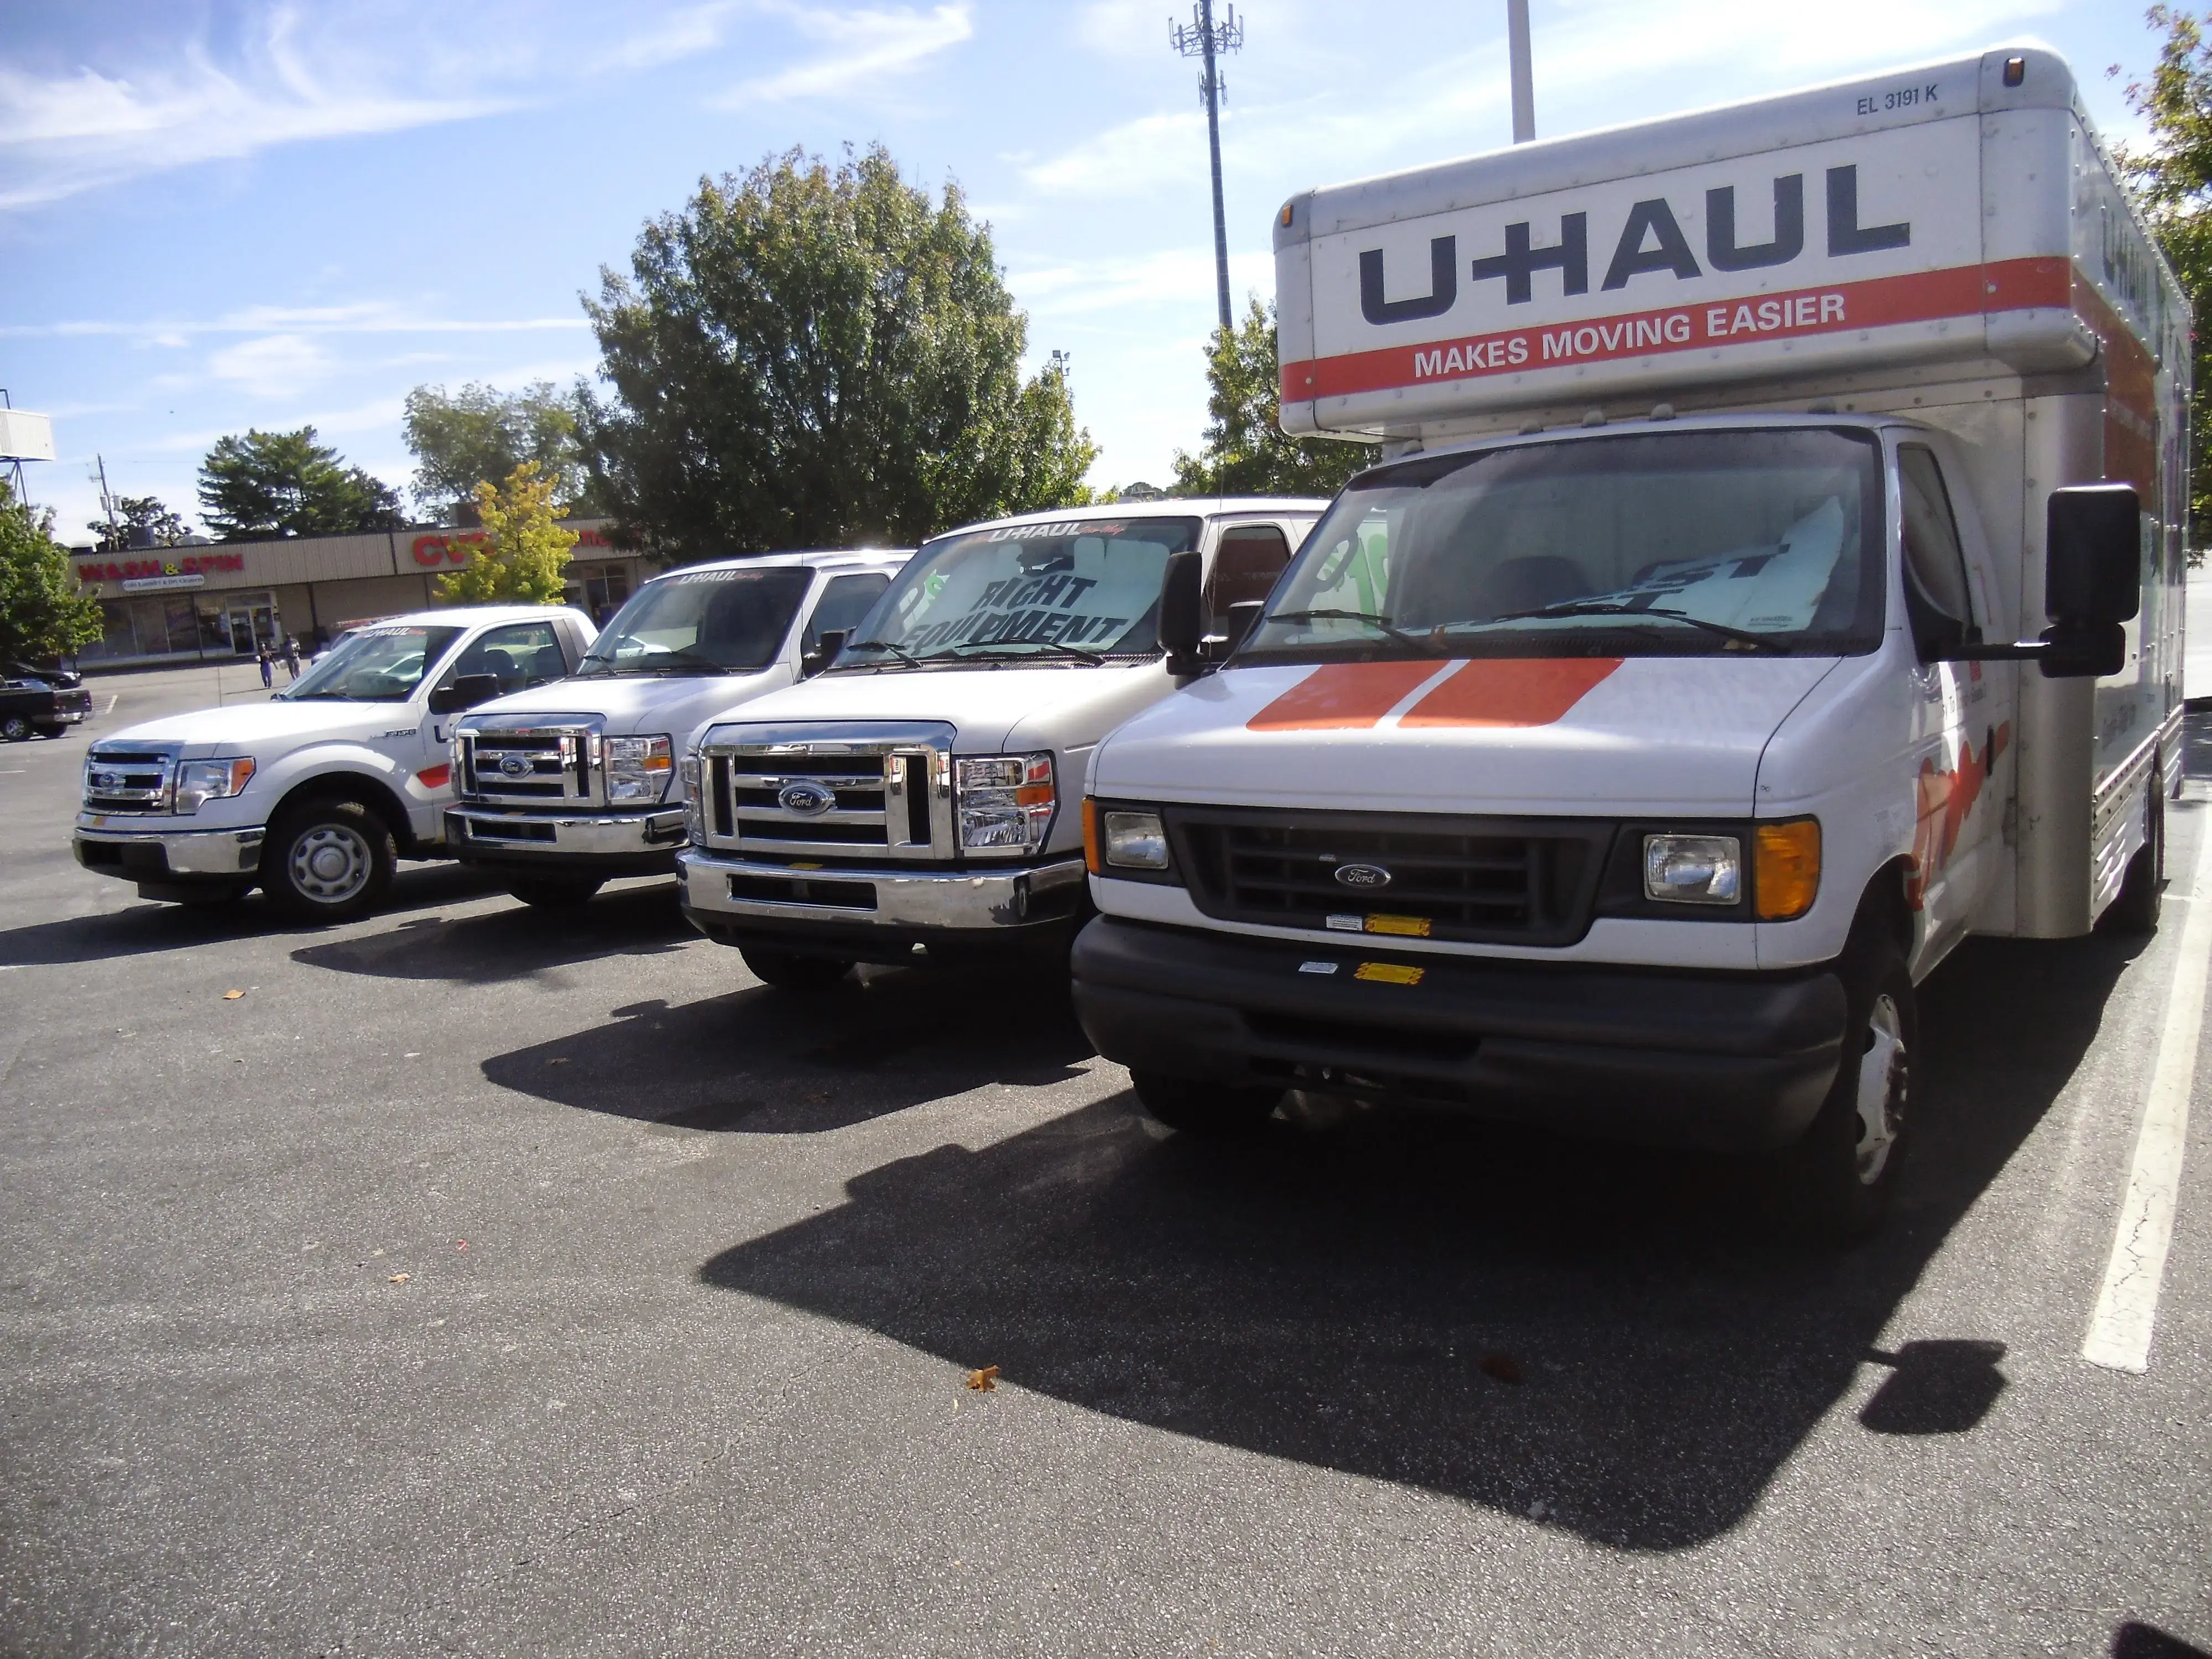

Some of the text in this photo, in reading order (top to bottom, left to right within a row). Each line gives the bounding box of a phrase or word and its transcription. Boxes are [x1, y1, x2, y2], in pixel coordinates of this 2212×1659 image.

[1857, 84, 1938, 116] EL 3191 K
[1359, 164, 1911, 326] U-HAUL
[1413, 294, 1845, 378] MAKES MOVING EASIER
[988, 523, 1080, 542] U-HAUL
[77, 554, 243, 581] WASH & SPIN
[678, 571, 737, 586] U-HAUL
[968, 574, 1099, 613] RIGHT
[899, 609, 1129, 656] EQUIPMENT
[789, 791, 813, 807] Ford
[1347, 868, 1376, 884] Ford
